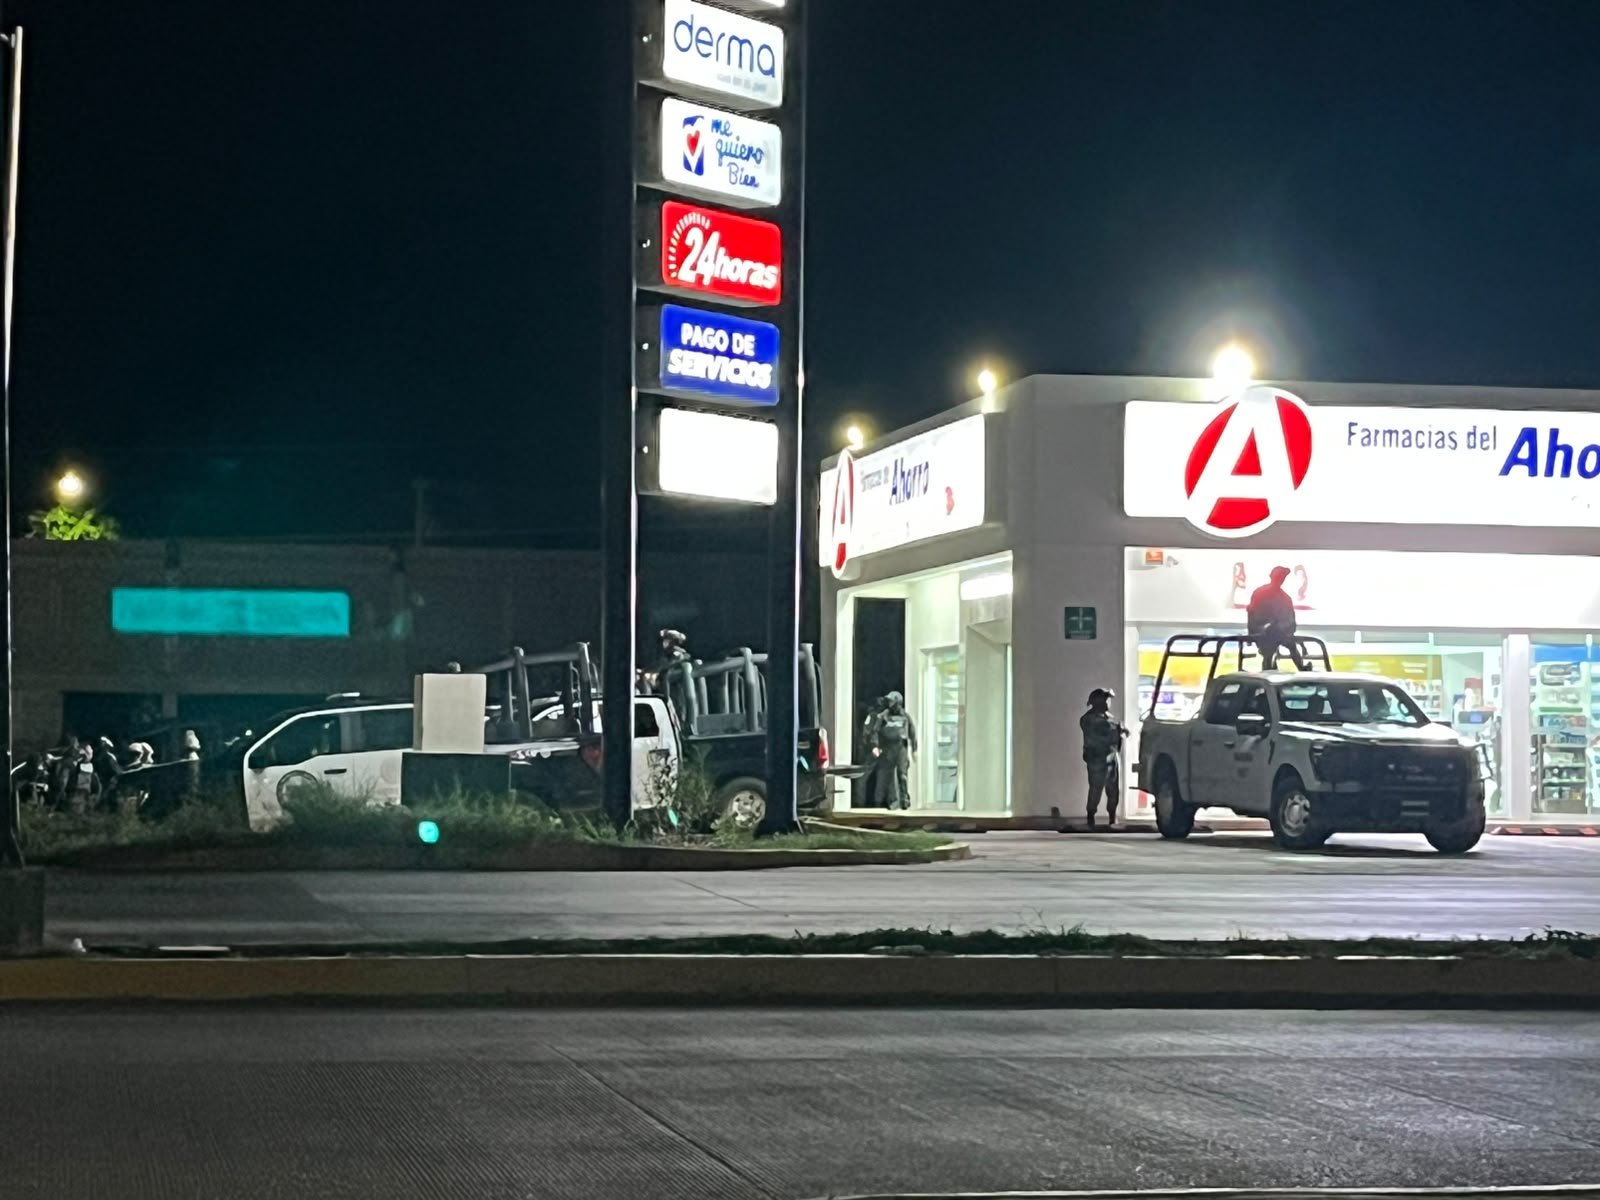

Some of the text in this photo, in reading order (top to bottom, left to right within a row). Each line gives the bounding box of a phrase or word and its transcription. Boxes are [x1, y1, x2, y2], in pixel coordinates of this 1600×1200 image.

[674, 14, 775, 78] derma
[711, 119, 733, 137] me
[716, 135, 764, 167] quiero
[681, 323, 755, 356] PAGO DE
[668, 349, 772, 389] SERVICIOS
[1347, 422, 1458, 450] Farmacias
[1466, 425, 1497, 450] del
[889, 457, 930, 505] Ahorro
